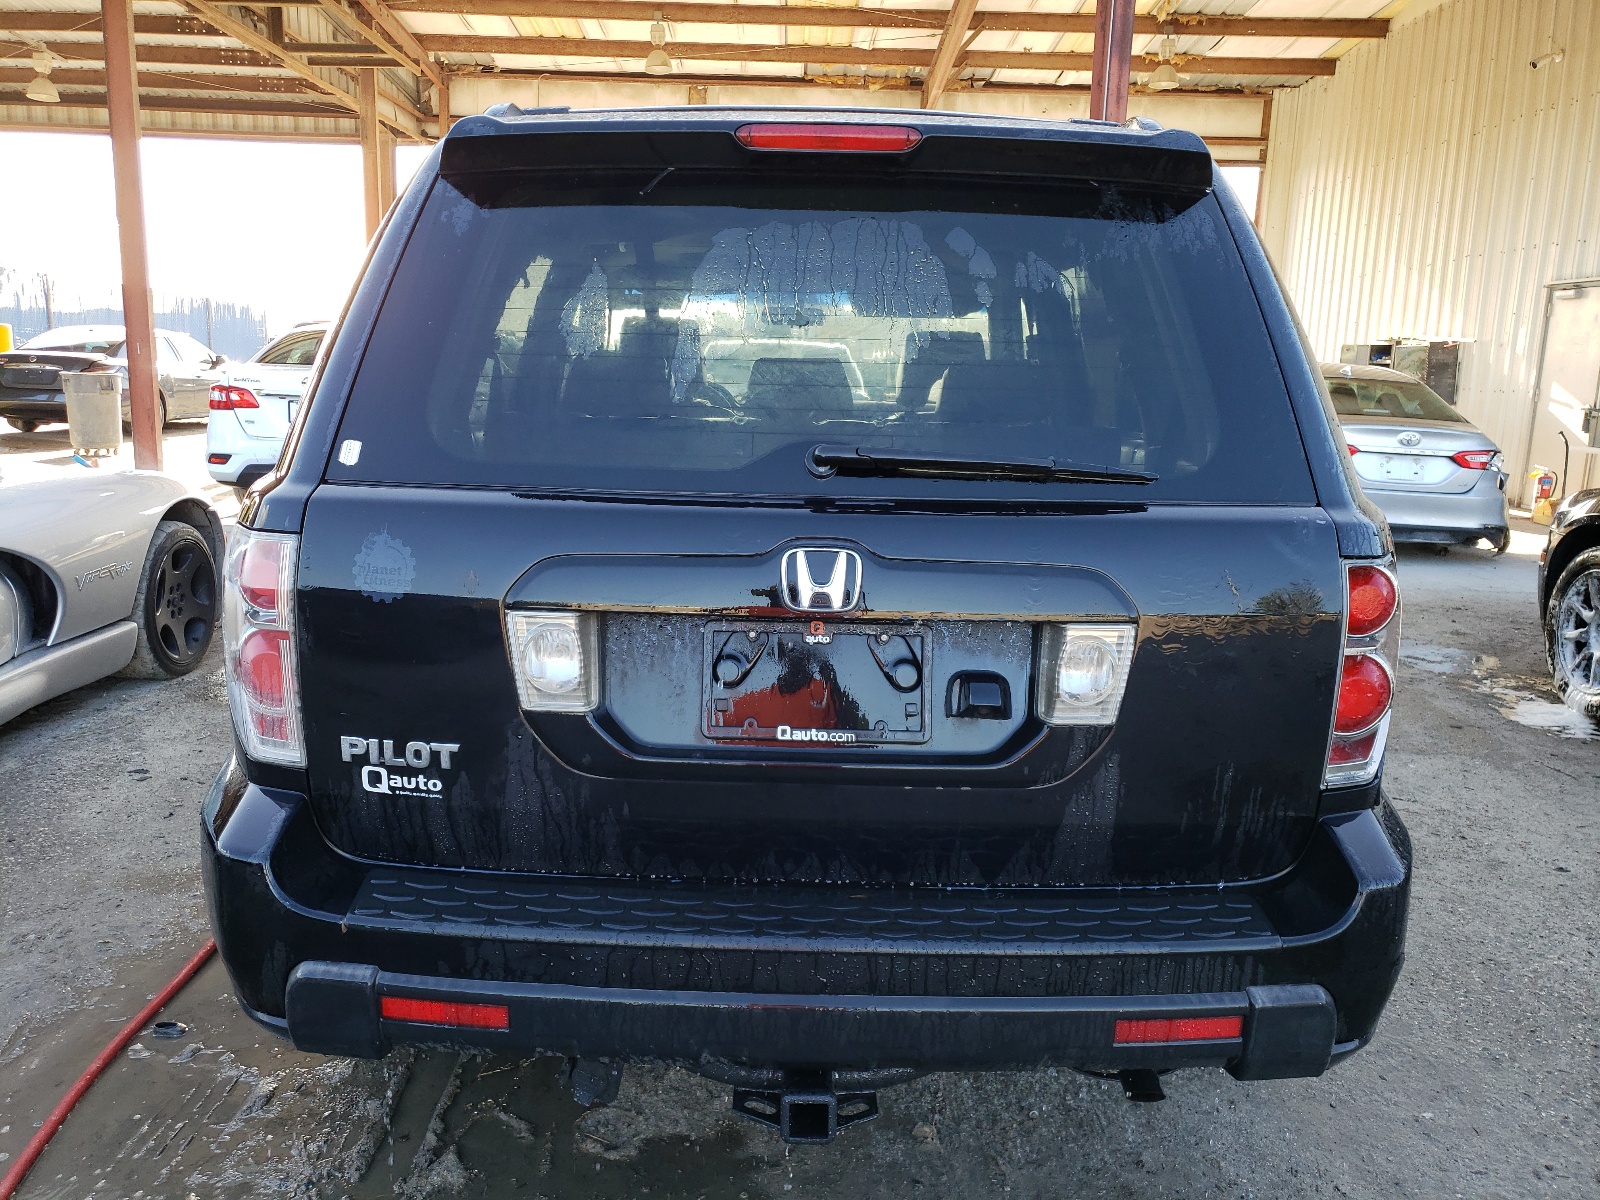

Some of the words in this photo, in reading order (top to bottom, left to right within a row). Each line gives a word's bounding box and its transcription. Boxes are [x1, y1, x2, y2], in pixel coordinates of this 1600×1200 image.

[805, 635, 830, 644] auto
[777, 725, 855, 742] Qauto.com
[340, 735, 461, 770] PILOT
[361, 765, 443, 795] Qauto
